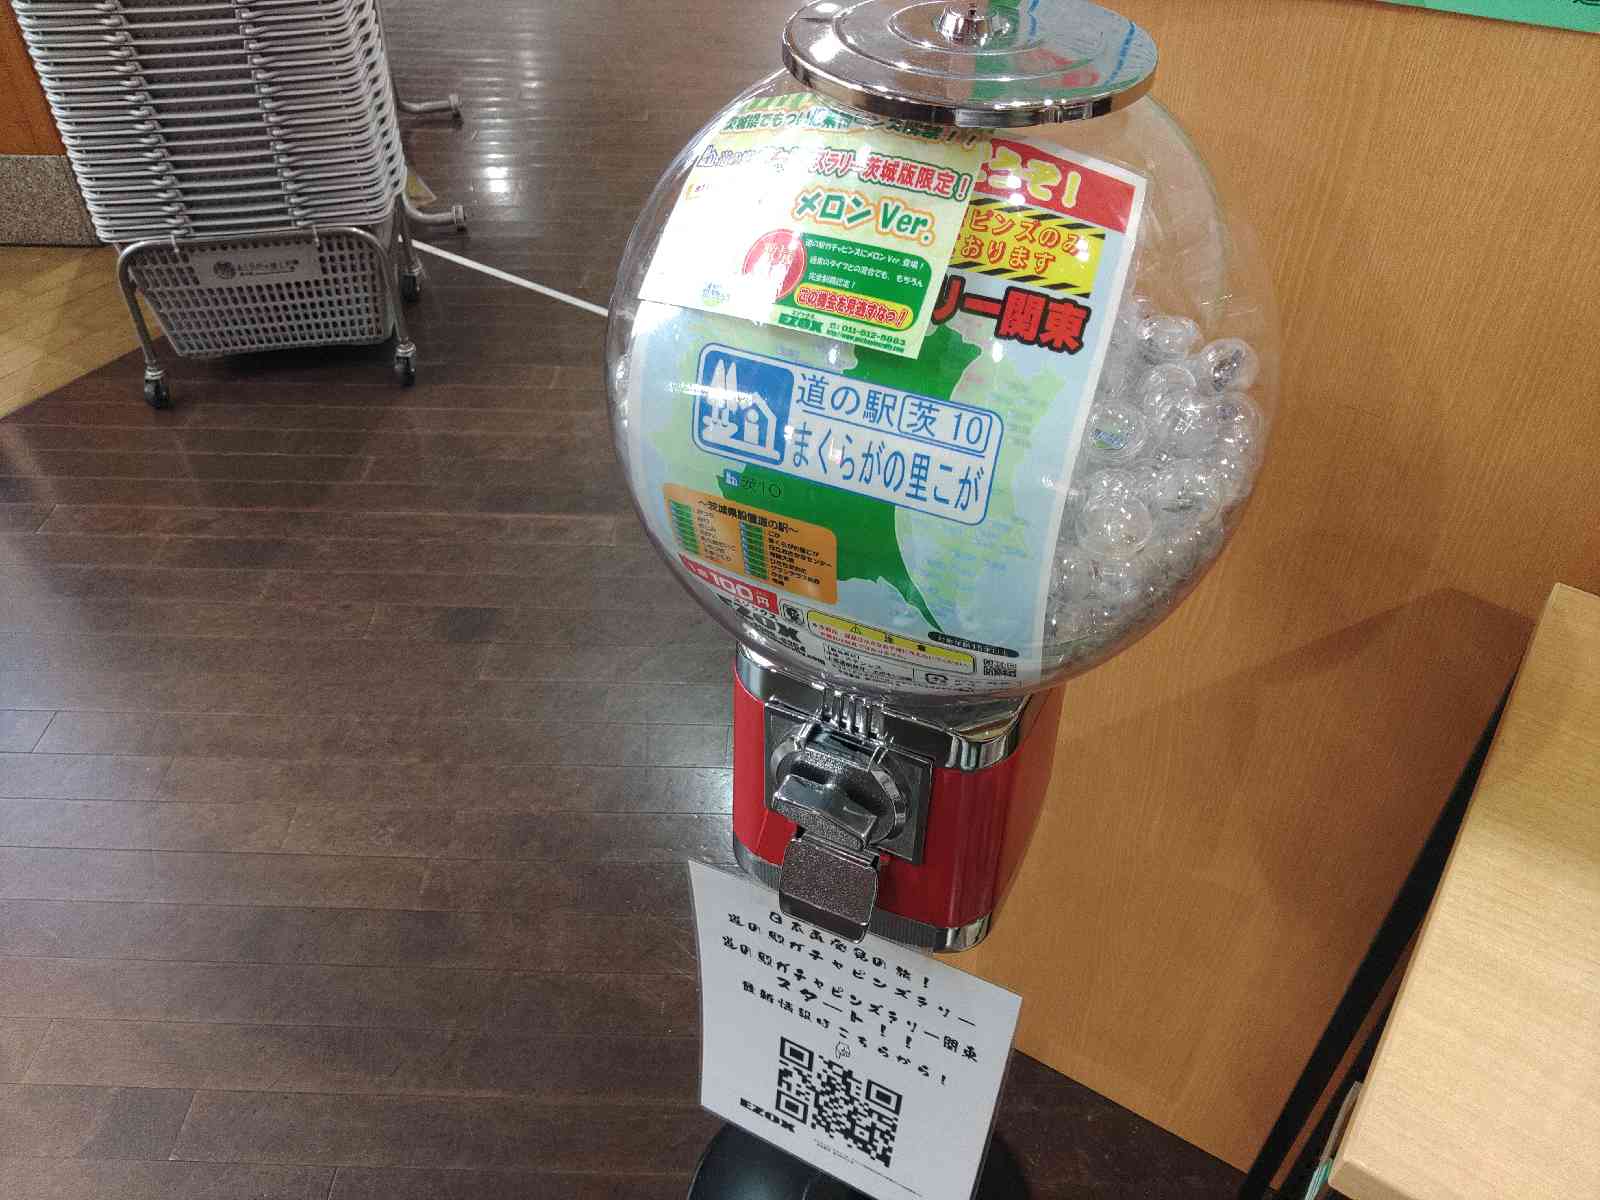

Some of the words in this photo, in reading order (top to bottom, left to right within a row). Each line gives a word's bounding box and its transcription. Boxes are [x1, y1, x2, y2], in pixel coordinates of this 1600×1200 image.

[953, 234, 1056, 274] おります
[962, 208, 1084, 258] ピンズのみ
[796, 372, 896, 427] 道の駅
[792, 420, 985, 511] まくらがの里こが
[721, 935, 979, 1064] 道の駅ガチャピンズラリー関東
[726, 912, 977, 1027] 道の駅ガチャピンズラリー
[741, 980, 947, 1086] 最新情報はこちらから！
[776, 976, 914, 1049] スタート！！
